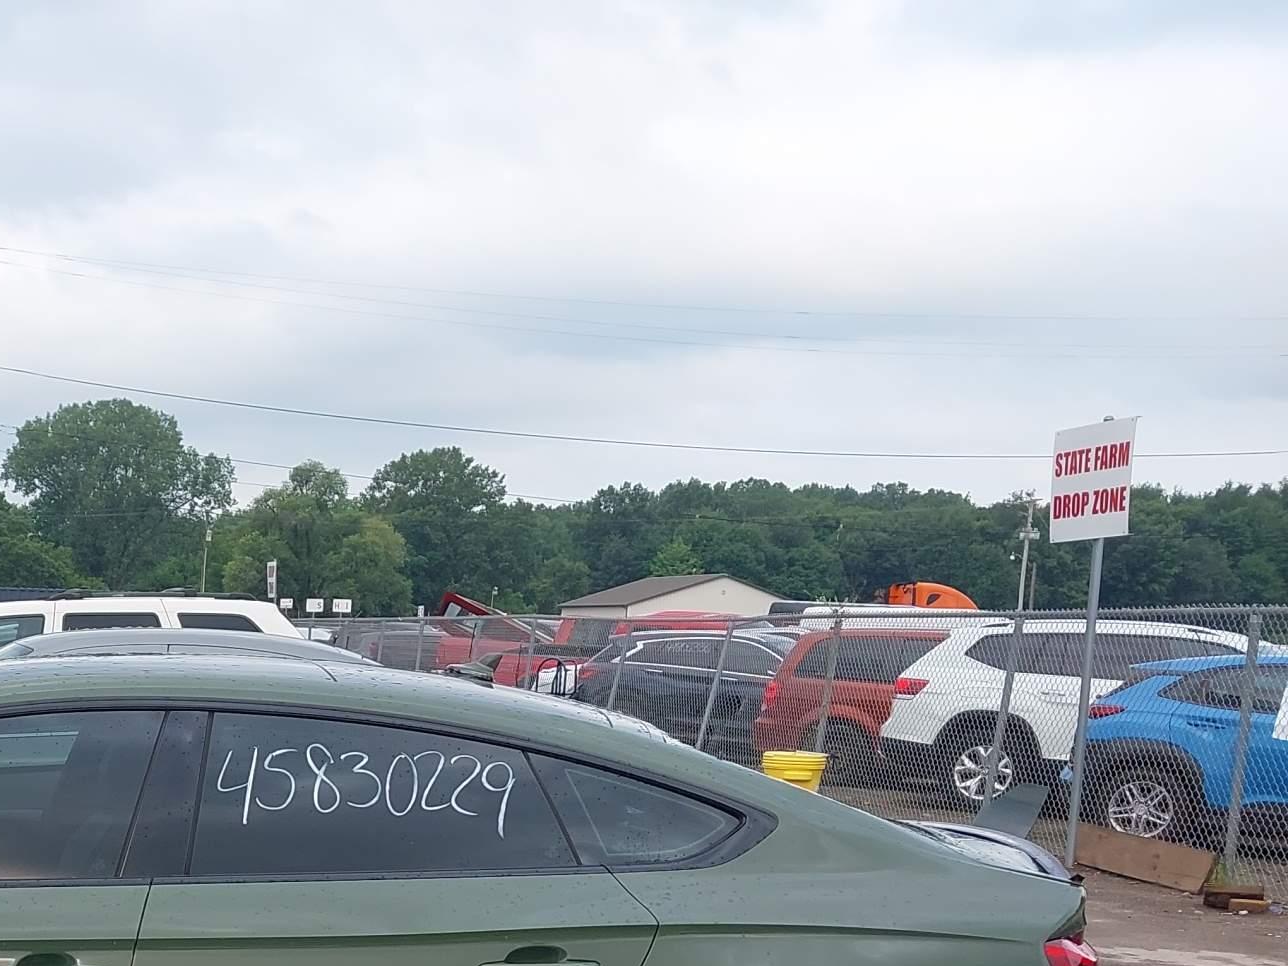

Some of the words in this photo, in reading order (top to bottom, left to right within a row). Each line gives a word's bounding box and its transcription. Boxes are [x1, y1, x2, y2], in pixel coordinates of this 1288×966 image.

[1054, 447, 1092, 478] STATE
[1094, 440, 1131, 471] FARM
[1052, 491, 1090, 520] DROP
[1092, 486, 1127, 515] ZONE
[216, 743, 517, 839] 45830229
